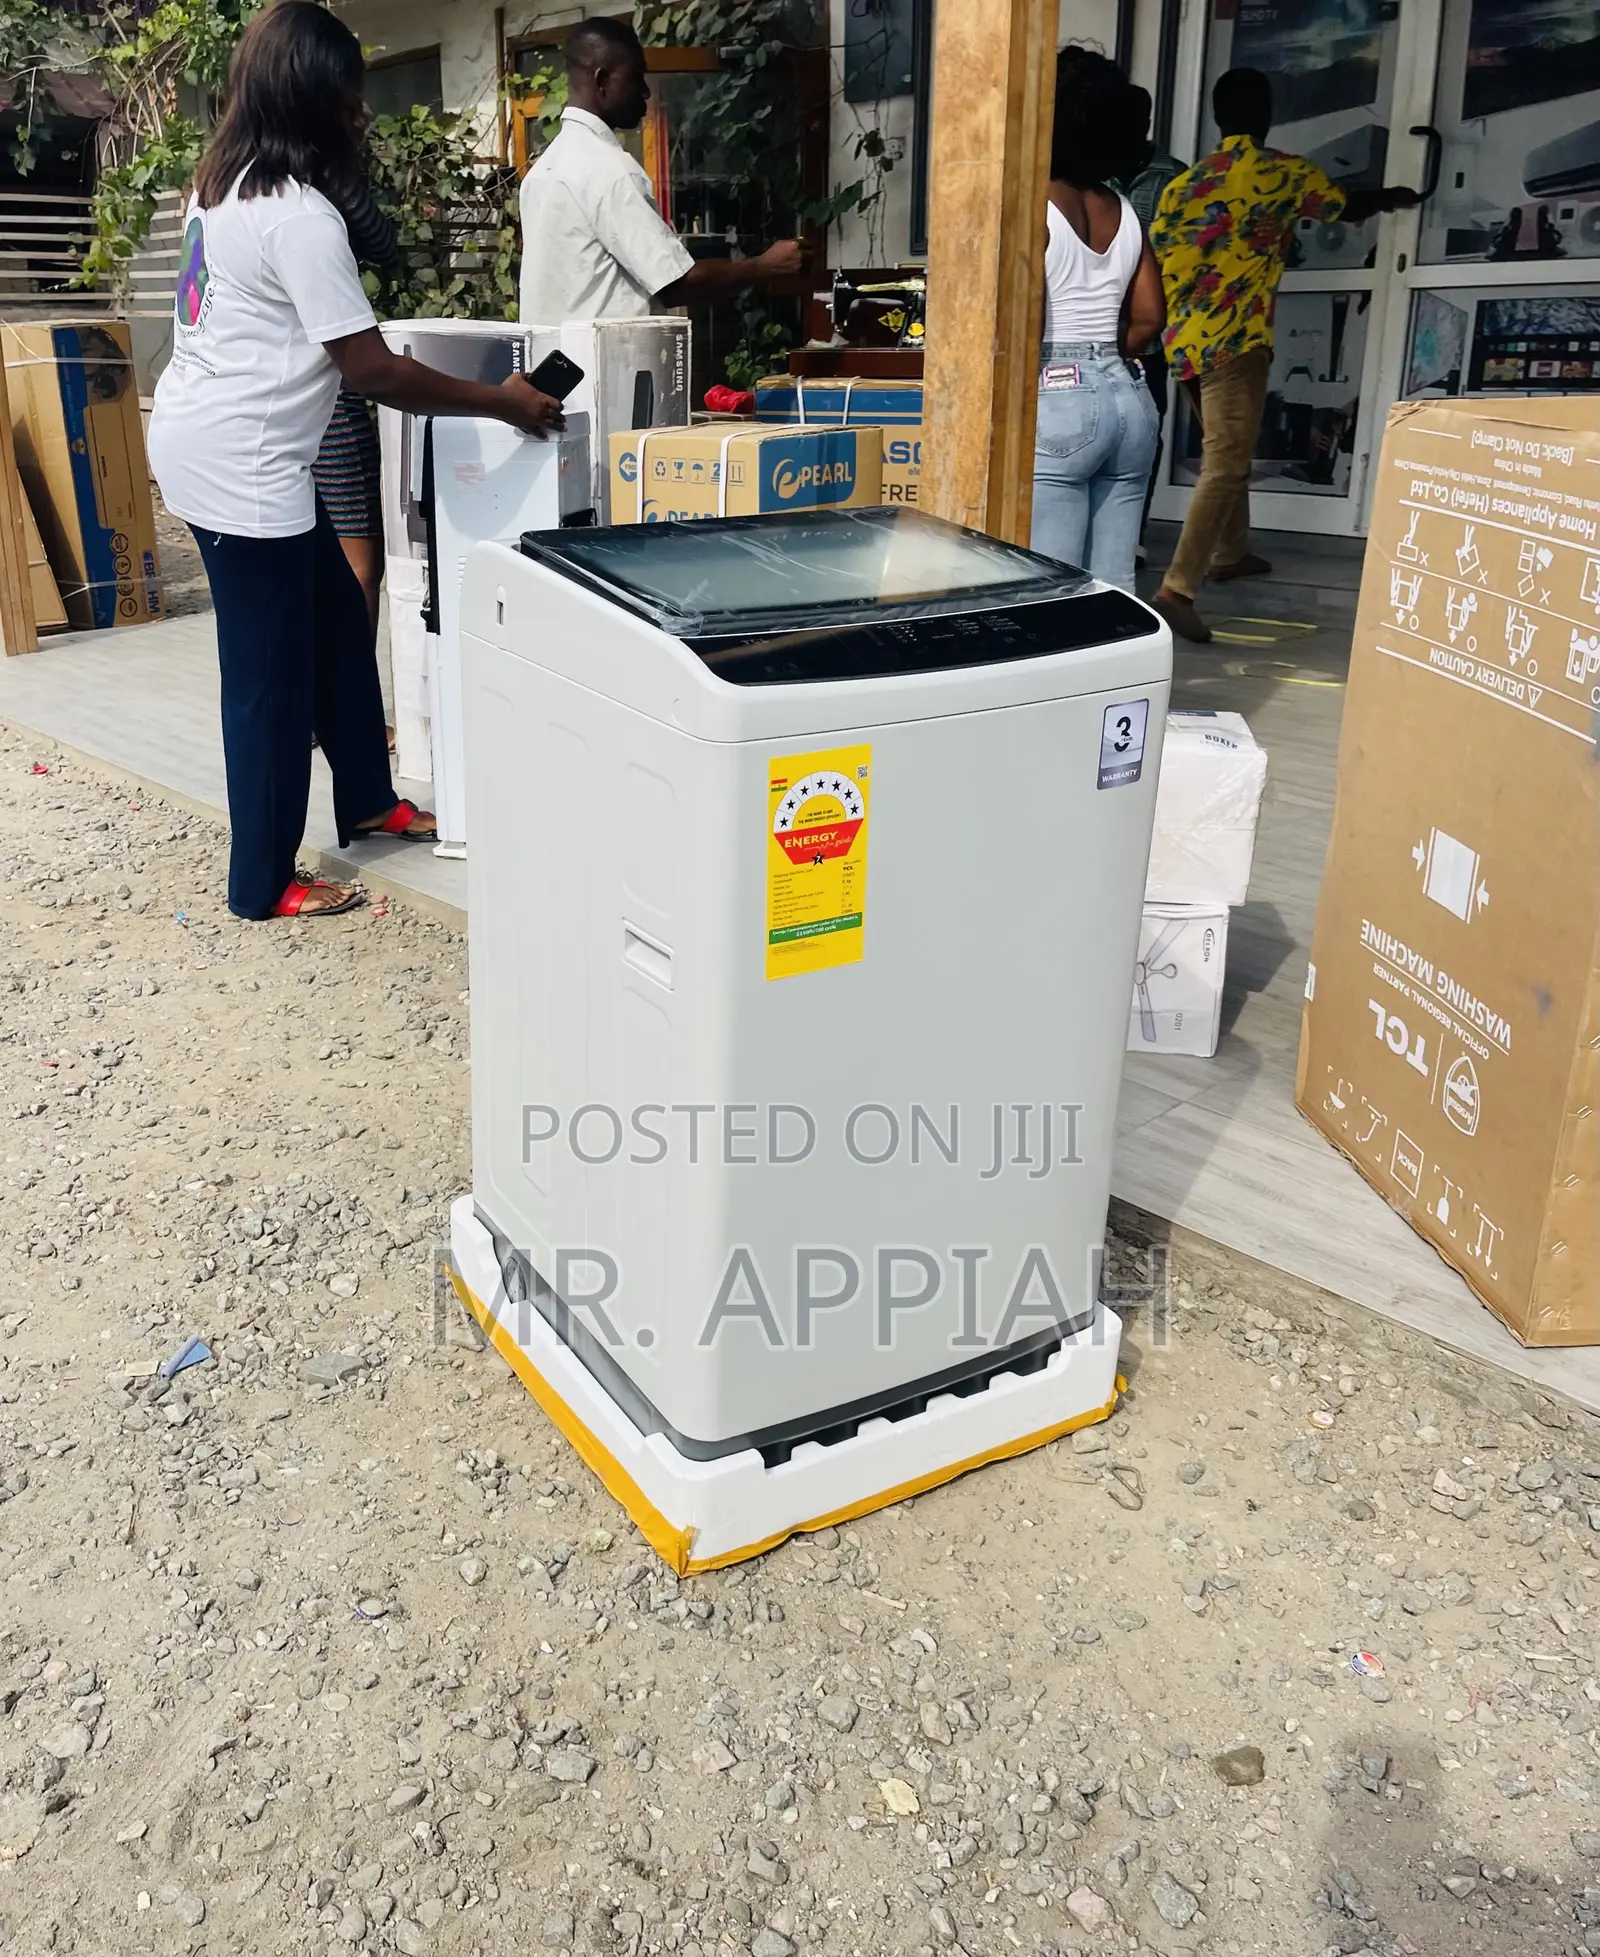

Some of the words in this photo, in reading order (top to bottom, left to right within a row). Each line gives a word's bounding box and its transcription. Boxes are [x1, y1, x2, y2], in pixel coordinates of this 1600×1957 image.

[512, 341, 521, 373] SAMS
[675, 334, 684, 392] SAMSUNG
[1505, 438, 1523, 455] Not
[1526, 442, 1540, 459] Do
[801, 462, 853, 488] PEARL
[1492, 497, 1558, 530] Appliances
[1559, 514, 1597, 541] Home
[1429, 647, 1475, 678] CAUTION
[1475, 666, 1525, 700] DELIVERY
[1102, 769, 1138, 783] WARRANTY
[784, 831, 839, 848] ENERGY
[1360, 918, 1434, 985] MACHINE
[1373, 962, 1410, 997] PARTNER
[1411, 990, 1452, 1029] REGIONAL
[1437, 970, 1511, 1049] WASHING
[1368, 998, 1429, 1077] TCL
[1453, 1022, 1490, 1059] OFFICIAL
[1397, 1149, 1418, 1177] BACK
